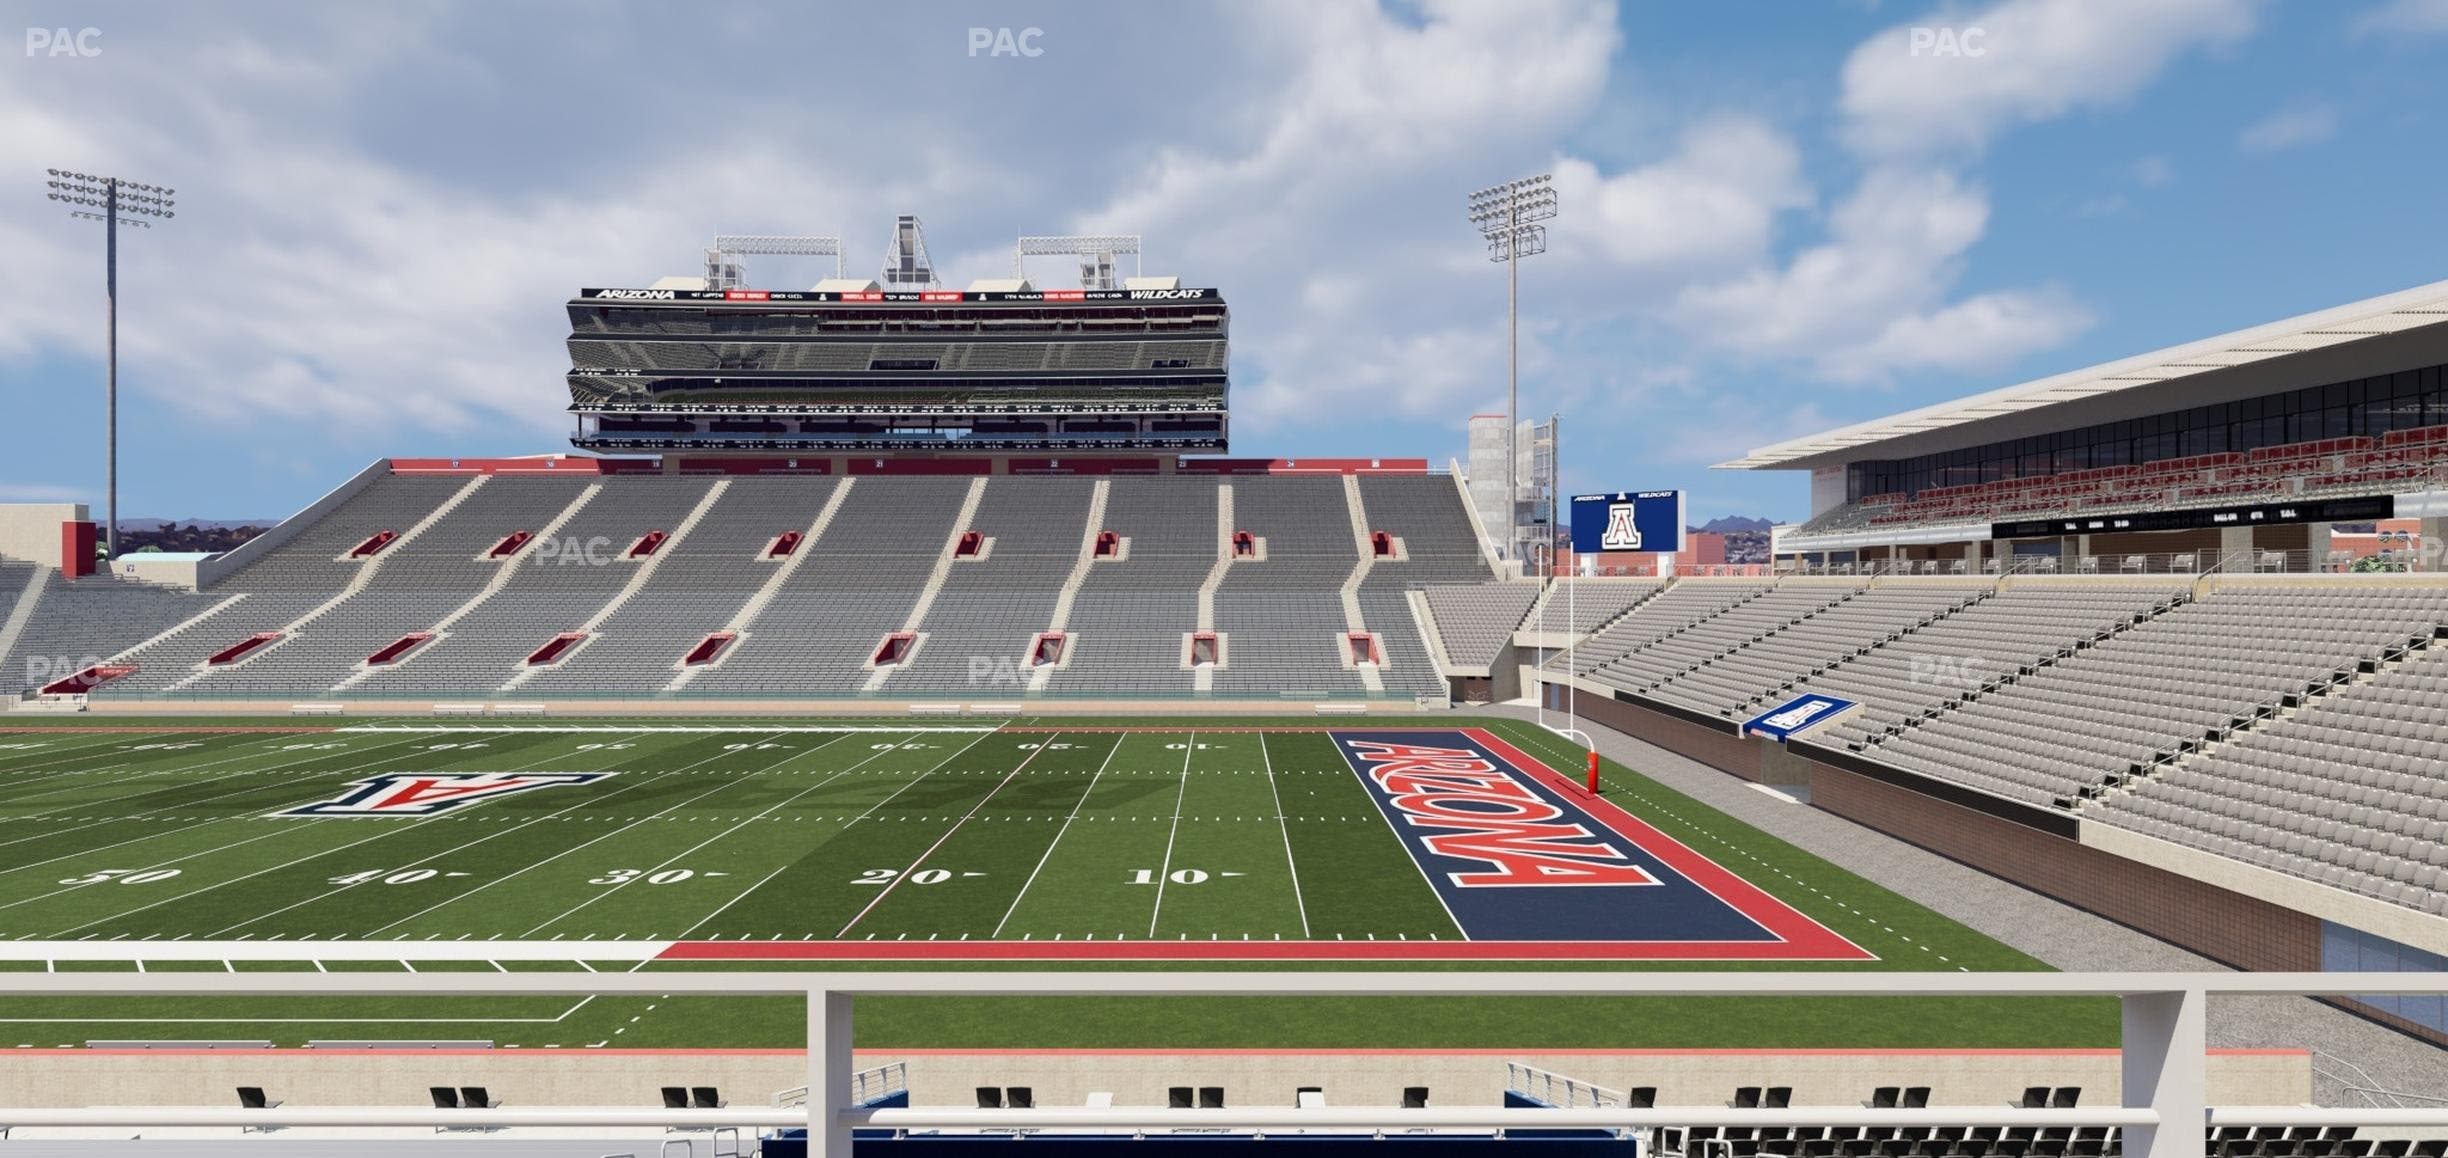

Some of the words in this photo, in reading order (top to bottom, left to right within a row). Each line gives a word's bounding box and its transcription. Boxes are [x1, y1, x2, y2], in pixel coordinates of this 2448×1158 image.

[596, 290, 675, 299] ARIZONA
[1130, 290, 1204, 300] WILDCATS
[1601, 503, 1642, 550] A
[1347, 740, 1665, 888] ARIZONA
[58, 869, 182, 885] 50
[327, 869, 438, 885] 40
[588, 869, 695, 885] 30
[850, 869, 952, 885] 20
[1124, 869, 1209, 885] 10
